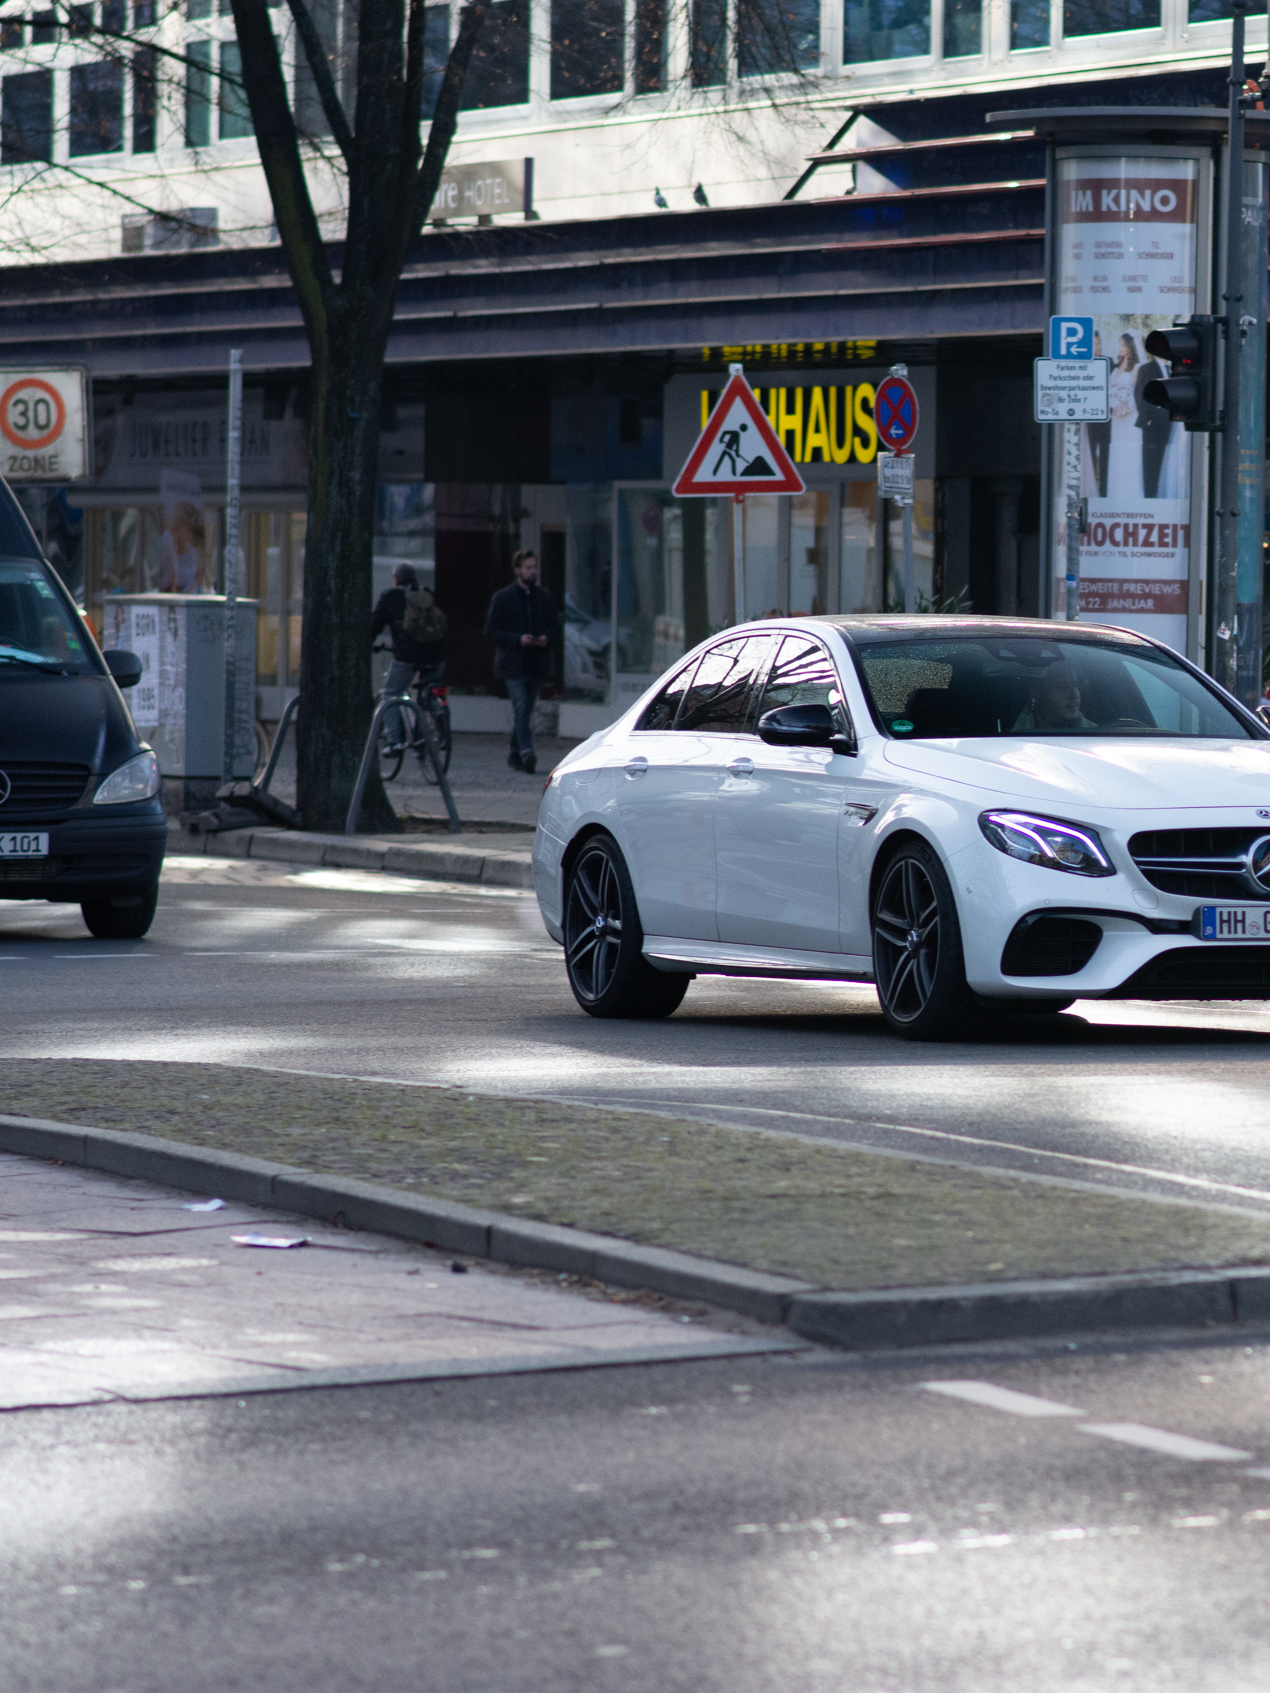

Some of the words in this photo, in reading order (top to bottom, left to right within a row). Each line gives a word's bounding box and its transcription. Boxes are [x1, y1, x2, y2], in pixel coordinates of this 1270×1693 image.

[464, 178, 510, 206] HOTEL
[1071, 190, 1094, 213] IM
[1101, 189, 1177, 213] KINO
[1060, 321, 1084, 355] P
[1040, 384, 1104, 392] Bewohnerparkausweis
[11, 398, 51, 431] 30
[8, 454, 60, 473] ZONE
[1080, 522, 1191, 549] HOCHZEIT
[1131, 551, 1175, 559] SCHWEIGER
[1123, 583, 1181, 595] PREVIEWS
[1106, 599, 1155, 610] JANUAR
[9, 835, 42, 853] 101
[1219, 911, 1246, 934] HH
